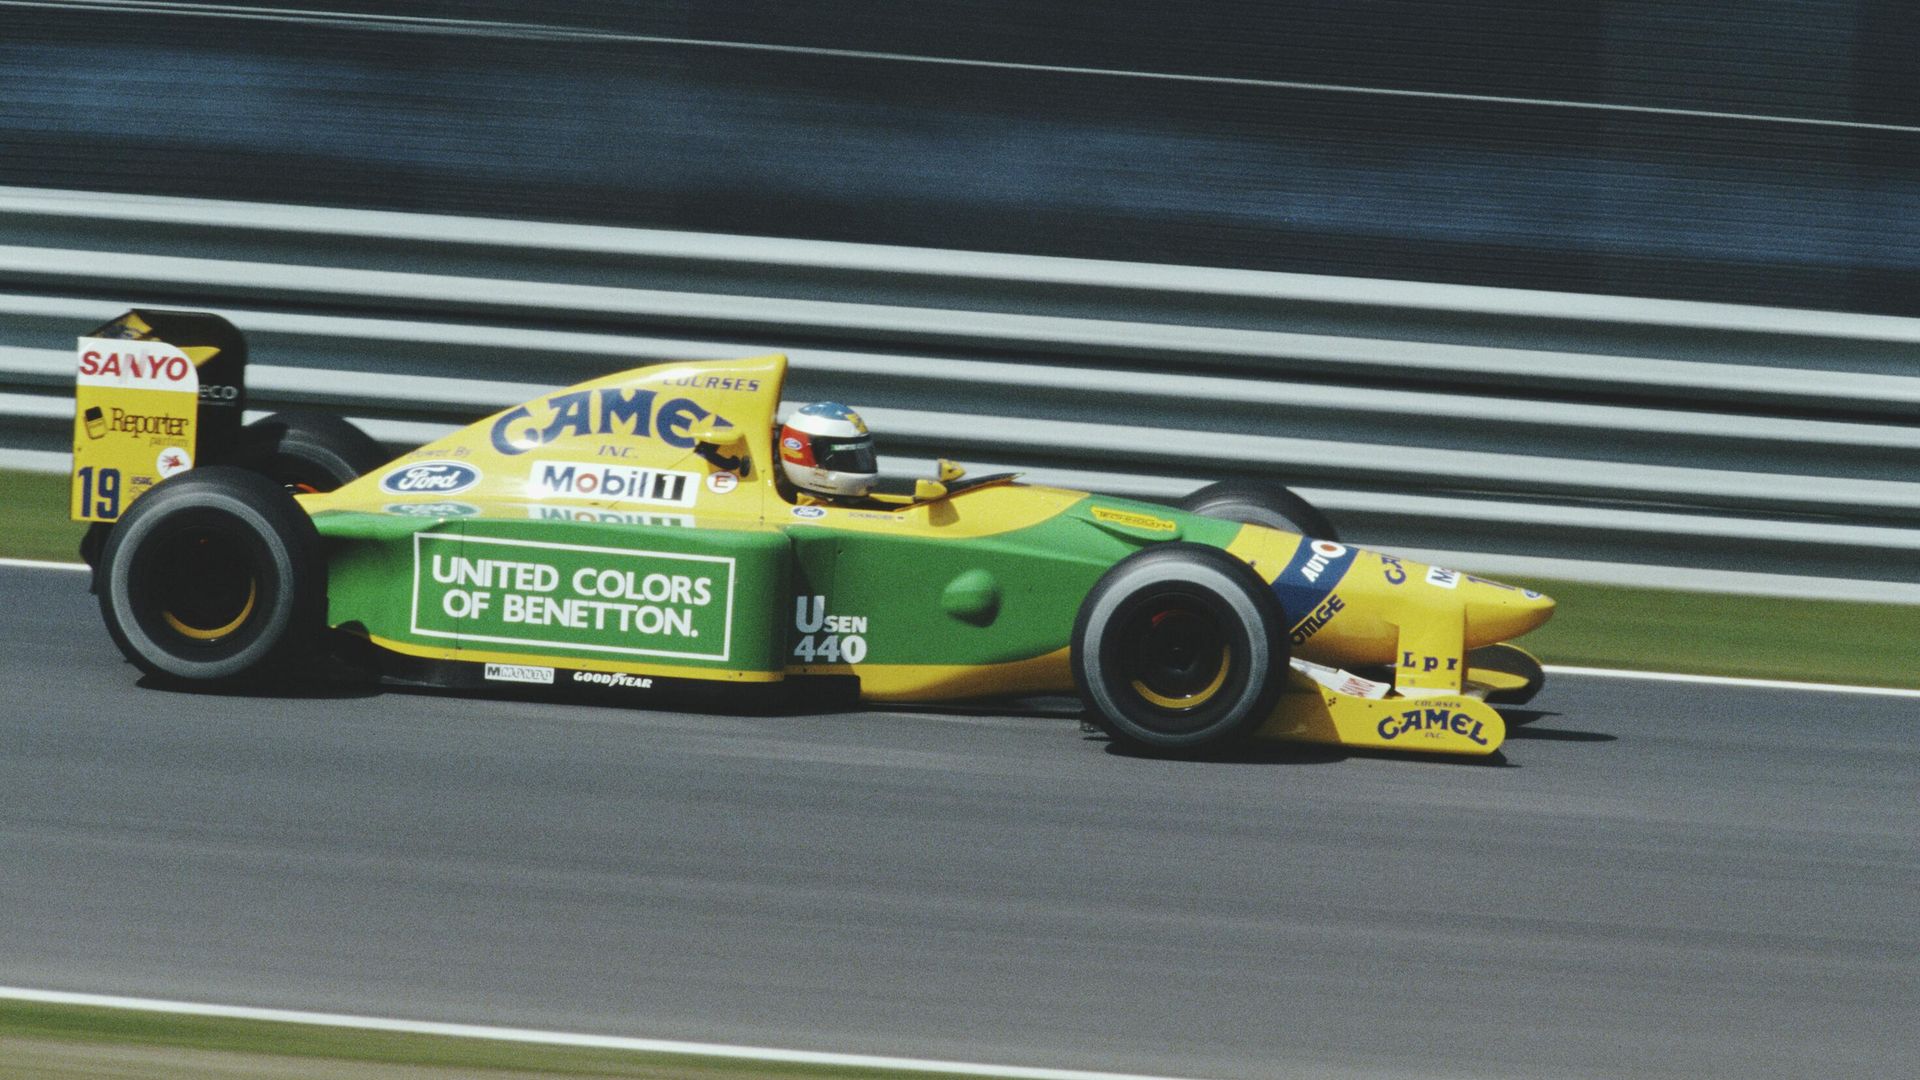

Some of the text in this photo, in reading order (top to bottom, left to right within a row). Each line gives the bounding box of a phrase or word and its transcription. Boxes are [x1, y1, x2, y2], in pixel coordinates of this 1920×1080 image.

[79, 350, 189, 382] SANYO
[110, 407, 189, 439] Reporter
[490, 388, 733, 456] CAME
[78, 466, 120, 519] 19
[397, 465, 462, 490] Ford
[542, 466, 649, 499] Mobil
[714, 475, 732, 489] E
[432, 554, 712, 606] UNITED COLORS
[442, 589, 699, 638] OF BENETTON.
[793, 634, 868, 664] 440
[573, 671, 653, 689] GOODYEAR
[1377, 708, 1488, 746] CAMEL
